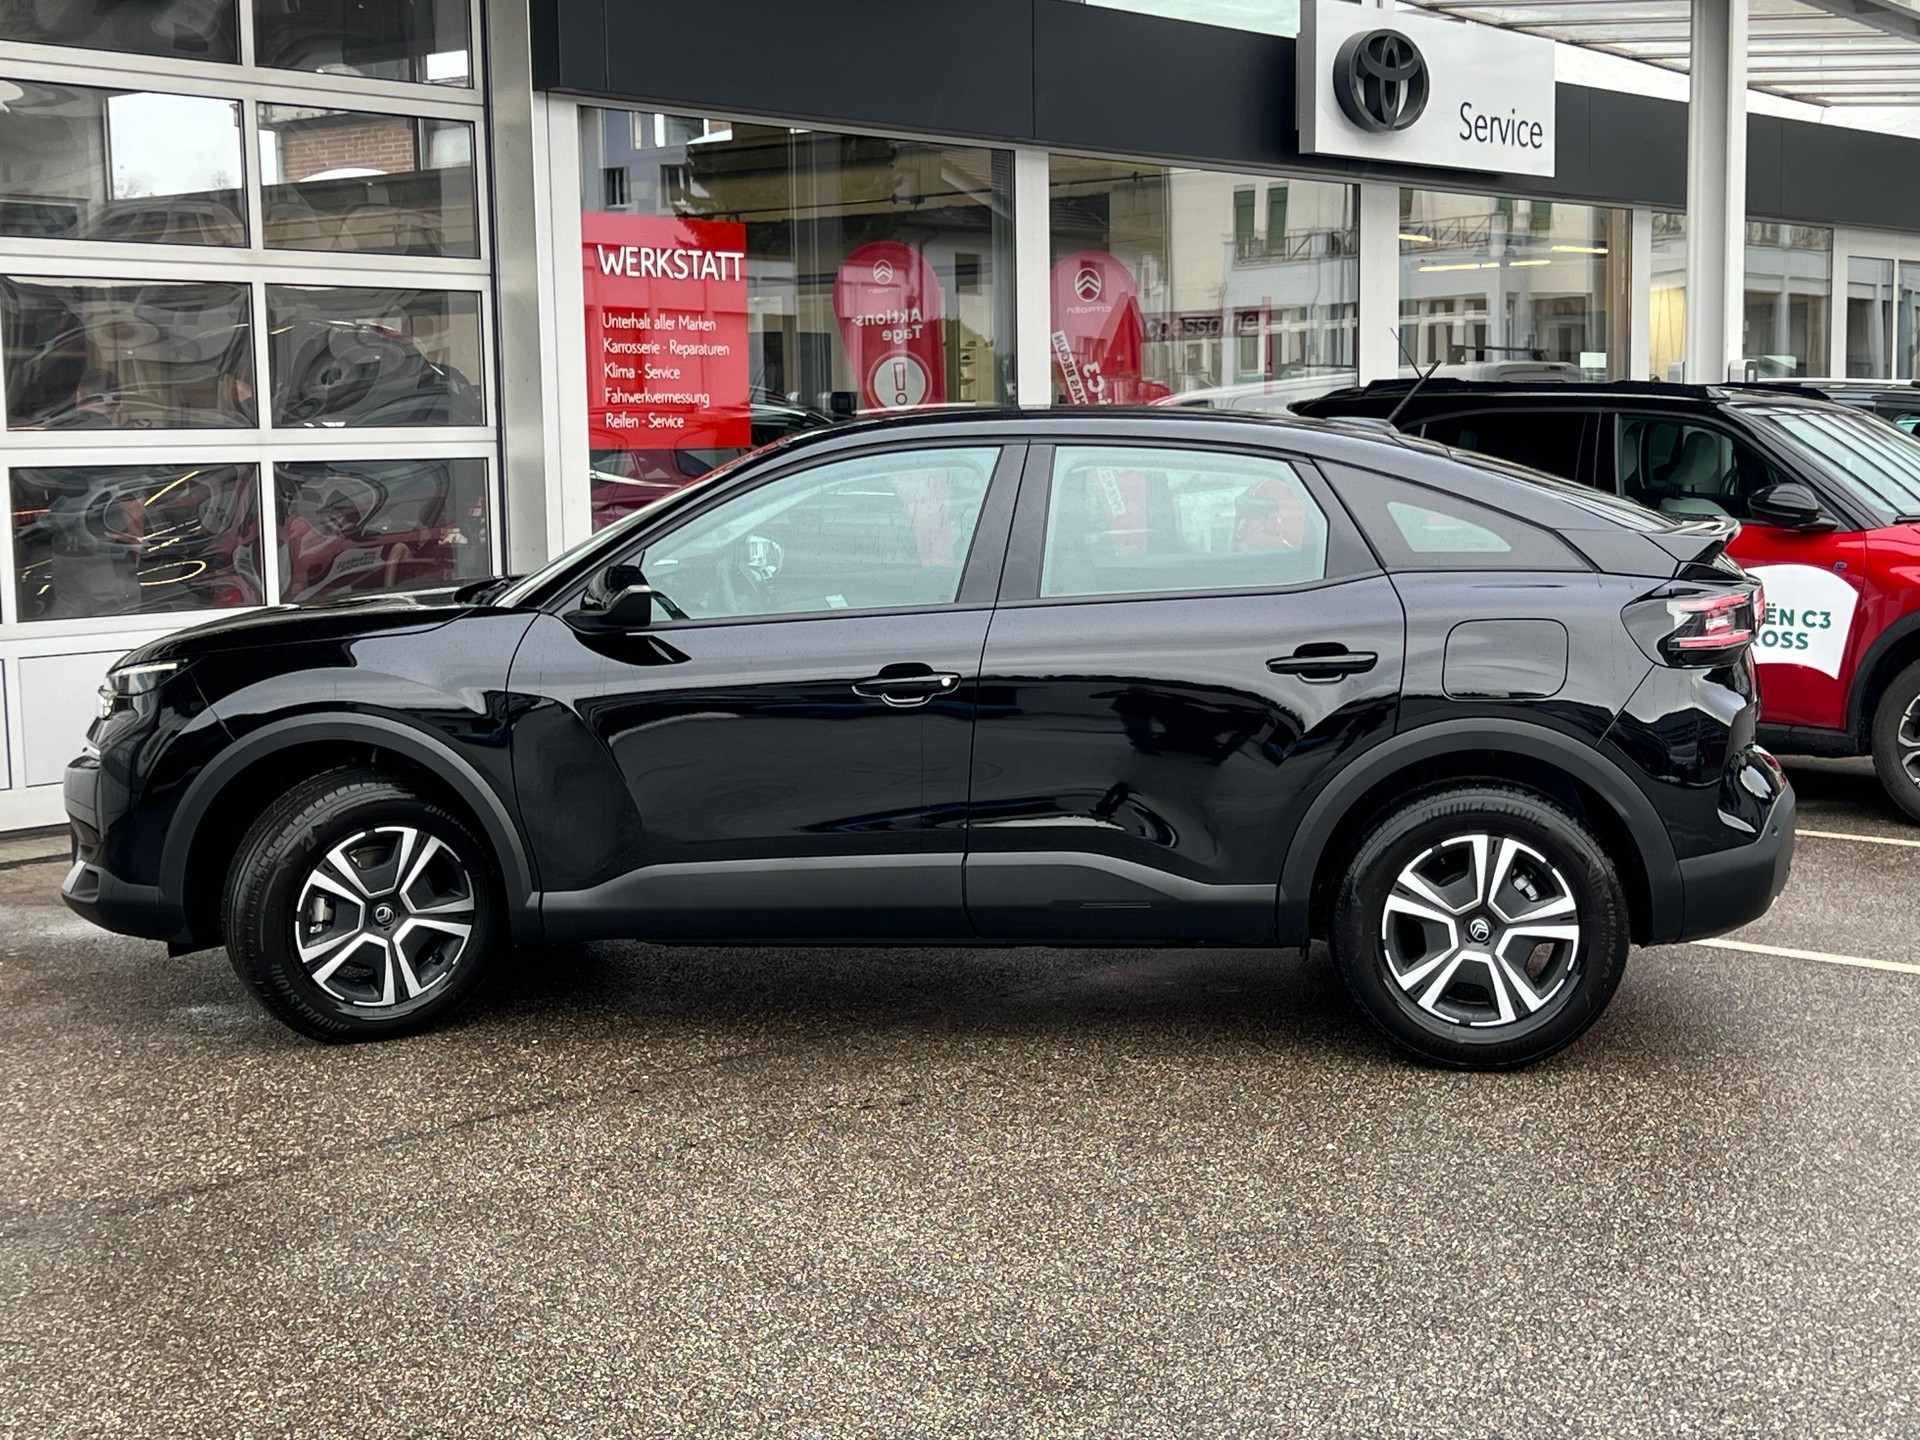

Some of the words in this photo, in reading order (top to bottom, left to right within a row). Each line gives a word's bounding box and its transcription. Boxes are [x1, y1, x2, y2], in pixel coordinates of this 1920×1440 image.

[1459, 101, 1543, 149] Service
[597, 244, 745, 282] WERKSTATT
[602, 312, 651, 329] Unterhalt
[653, 313, 676, 330] aller
[678, 314, 717, 331] Marken
[603, 337, 661, 355] Karrosserie
[669, 339, 730, 359] Reparaturen
[604, 361, 635, 379] Klima
[644, 362, 681, 380] Service
[604, 386, 710, 409] Fahrwerkvermessung
[605, 411, 639, 429] Reifen
[648, 412, 685, 429] Service
[1802, 609, 1832, 629] C3
[1753, 629, 1809, 650] OSS
